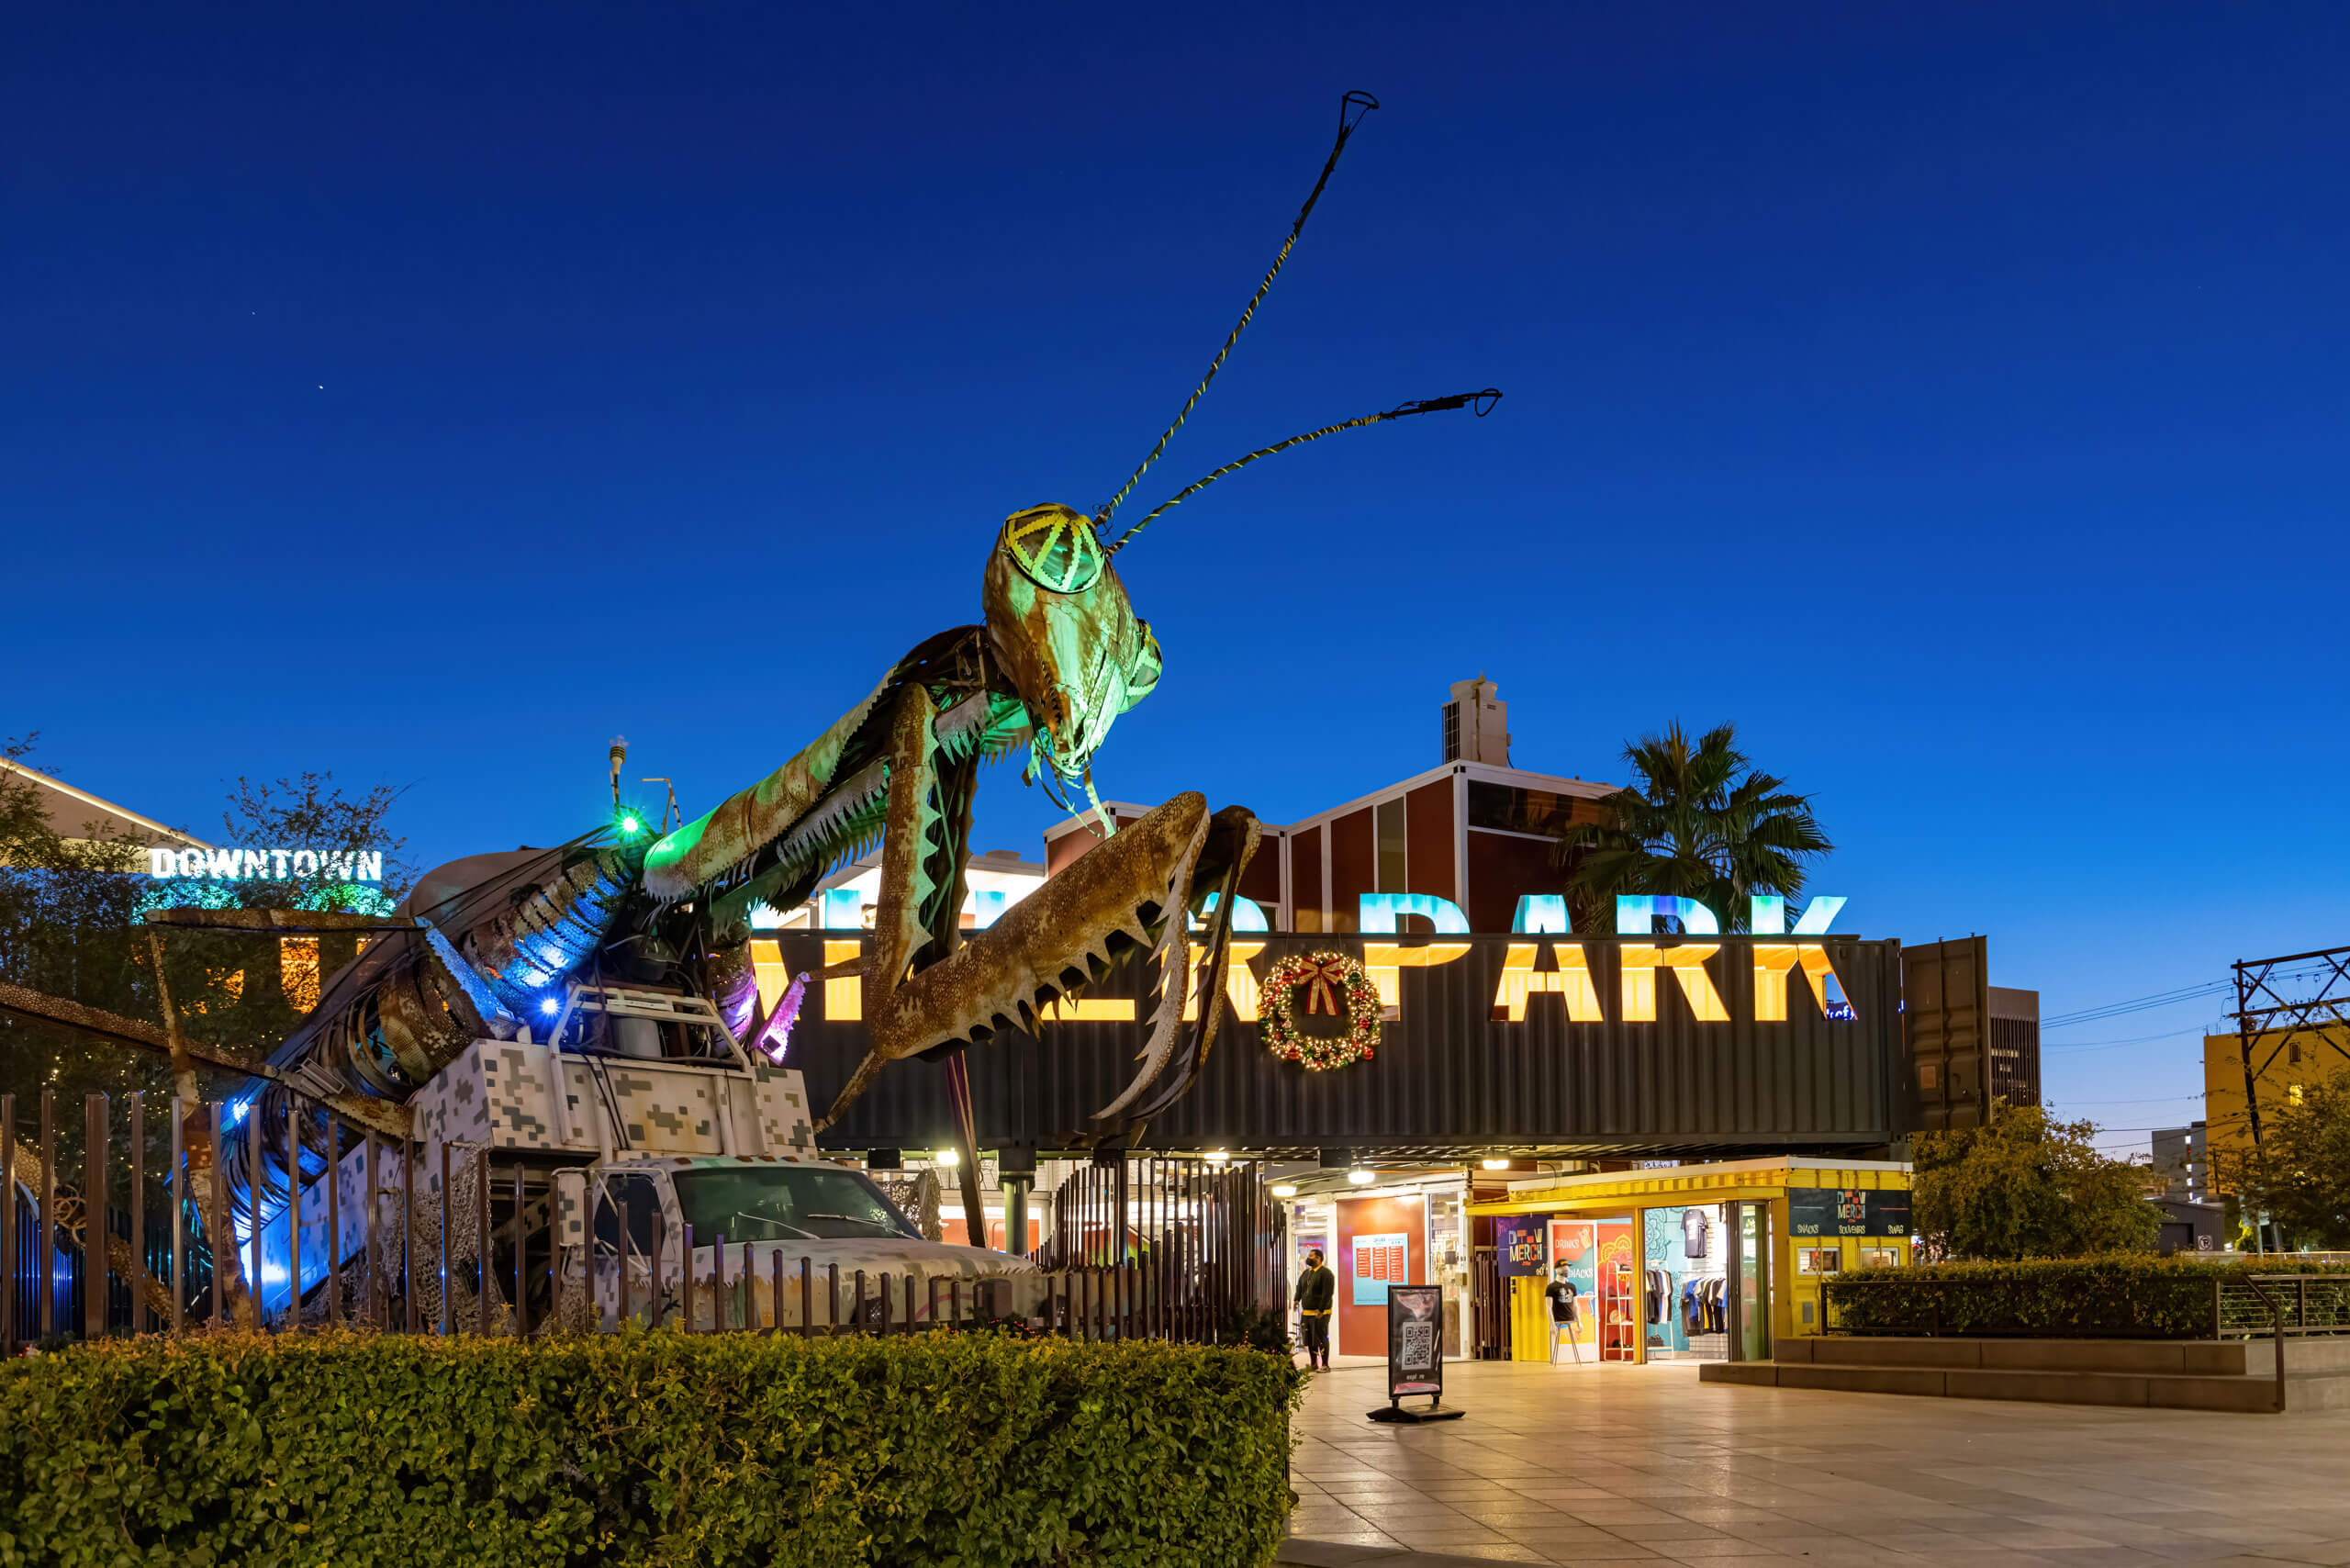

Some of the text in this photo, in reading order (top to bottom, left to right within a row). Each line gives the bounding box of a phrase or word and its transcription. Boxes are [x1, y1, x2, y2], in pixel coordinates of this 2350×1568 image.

[151, 848, 383, 881] DOWNTOWN
[1359, 892, 1858, 1022] PARK
[1837, 1204, 1866, 1219] MERCH
[1796, 1224, 1819, 1234] SNACKS
[1887, 1224, 1904, 1235] SWAG
[1555, 1239, 1580, 1249] DRINKS
[1509, 1243, 1543, 1263] MERCH
